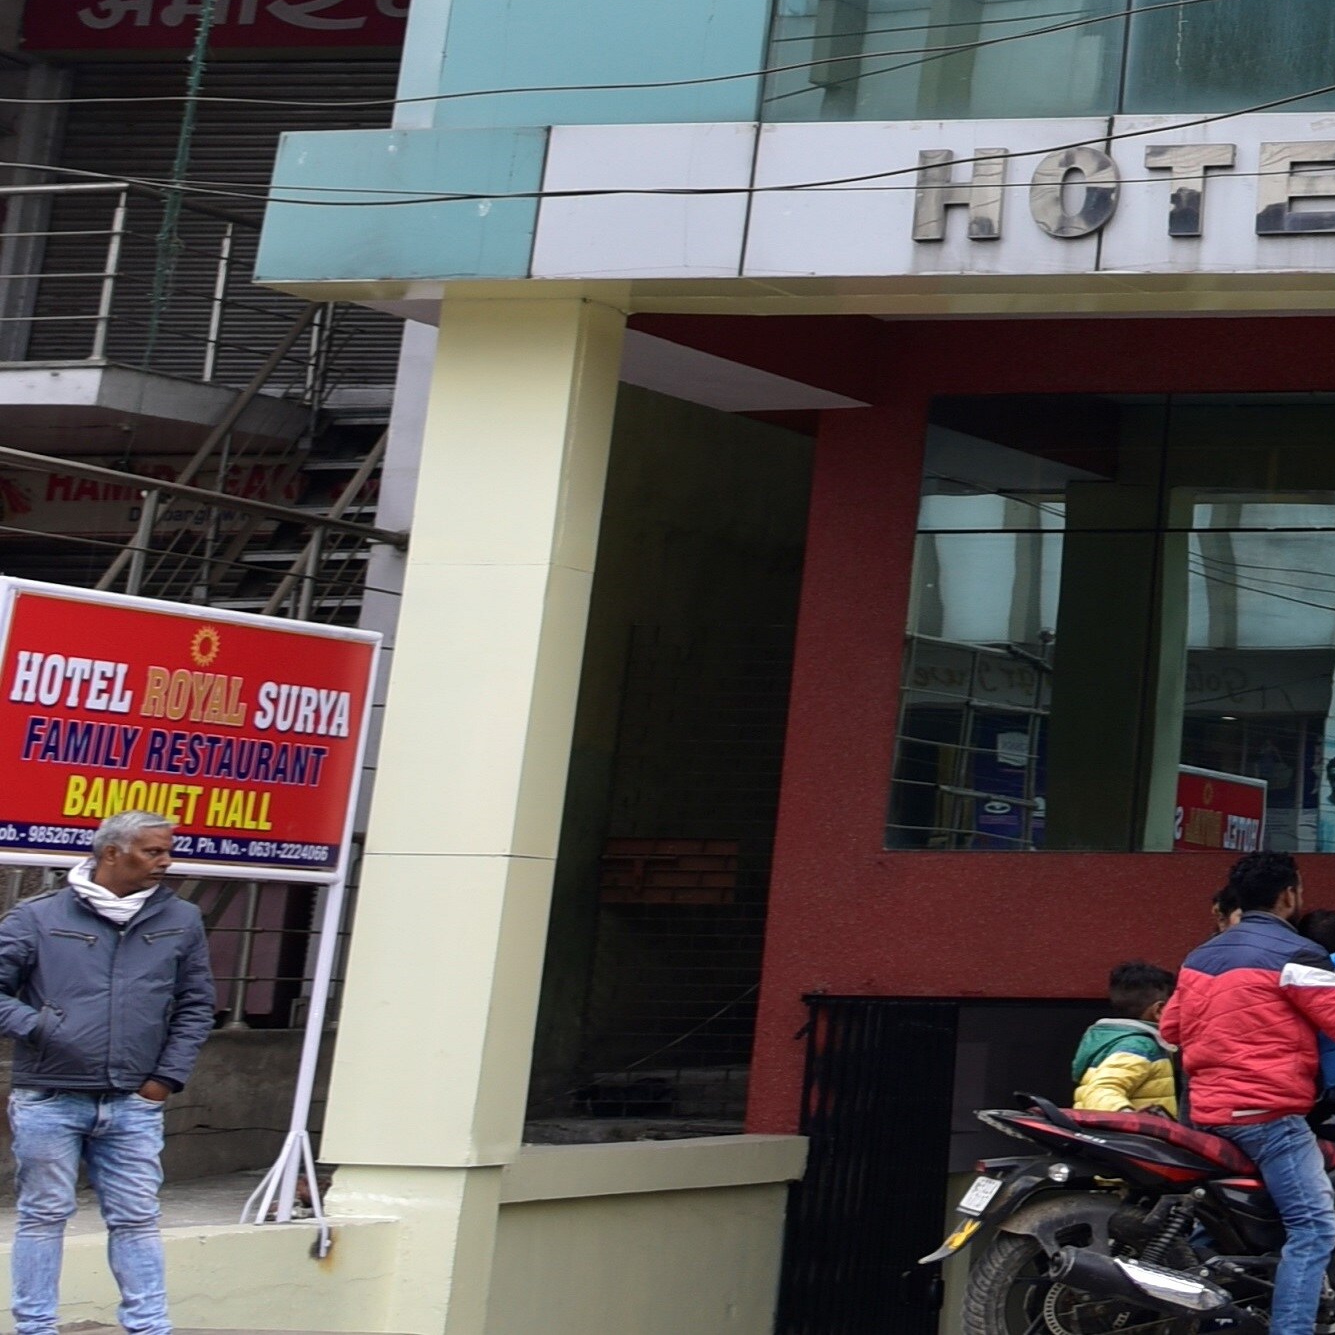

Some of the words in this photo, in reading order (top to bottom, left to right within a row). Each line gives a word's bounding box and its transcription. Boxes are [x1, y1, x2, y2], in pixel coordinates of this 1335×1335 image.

[10, 650, 133, 714] HOTEL
[140, 665, 248, 727] ROYAL
[253, 680, 351, 738] SURYA
[20, 715, 143, 770] FAMILY
[144, 727, 329, 788] RESTAURANT
[28, 825, 96, 846] 98526739
[206, 787, 273, 831] HALL
